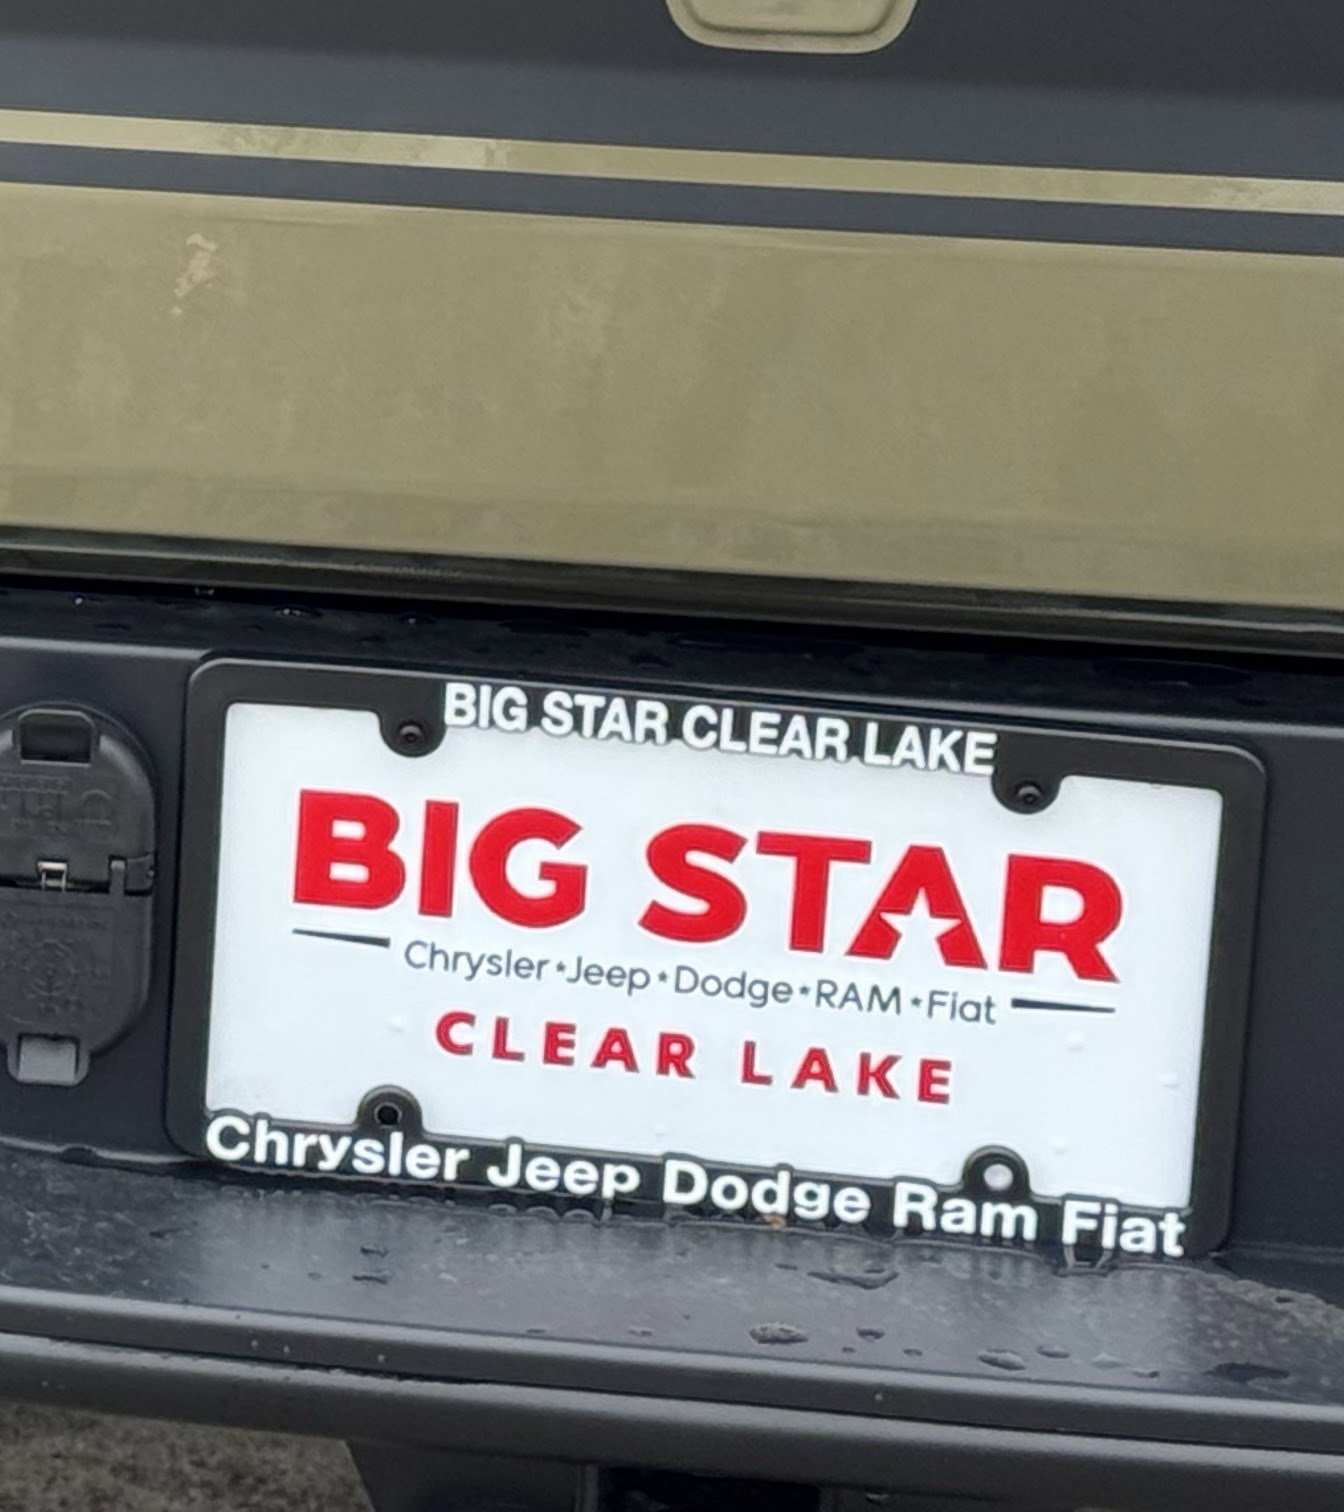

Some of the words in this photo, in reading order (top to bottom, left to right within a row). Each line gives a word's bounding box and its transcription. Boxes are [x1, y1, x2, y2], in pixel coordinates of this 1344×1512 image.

[444, 681, 528, 732] BIG
[541, 690, 669, 744] STAR
[682, 704, 850, 762] CLEAR
[863, 721, 998, 775] LAKE
[293, 788, 589, 928] BIG
[638, 823, 1124, 982] STAR
[404, 939, 550, 981] Chrysler
[566, 955, 651, 996] Jeep
[674, 965, 793, 1008] Dodge
[814, 978, 902, 1015] RAM
[927, 990, 996, 1025] Fiat
[435, 1011, 696, 1079] CLEAR
[741, 1040, 952, 1105] LAKE
[206, 1115, 470, 1180] Chrysler
[486, 1143, 641, 1198] Jeep
[662, 1158, 871, 1222] Dodge
[893, 1181, 1038, 1240] Ram
[1062, 1198, 1186, 1256] Fiat
